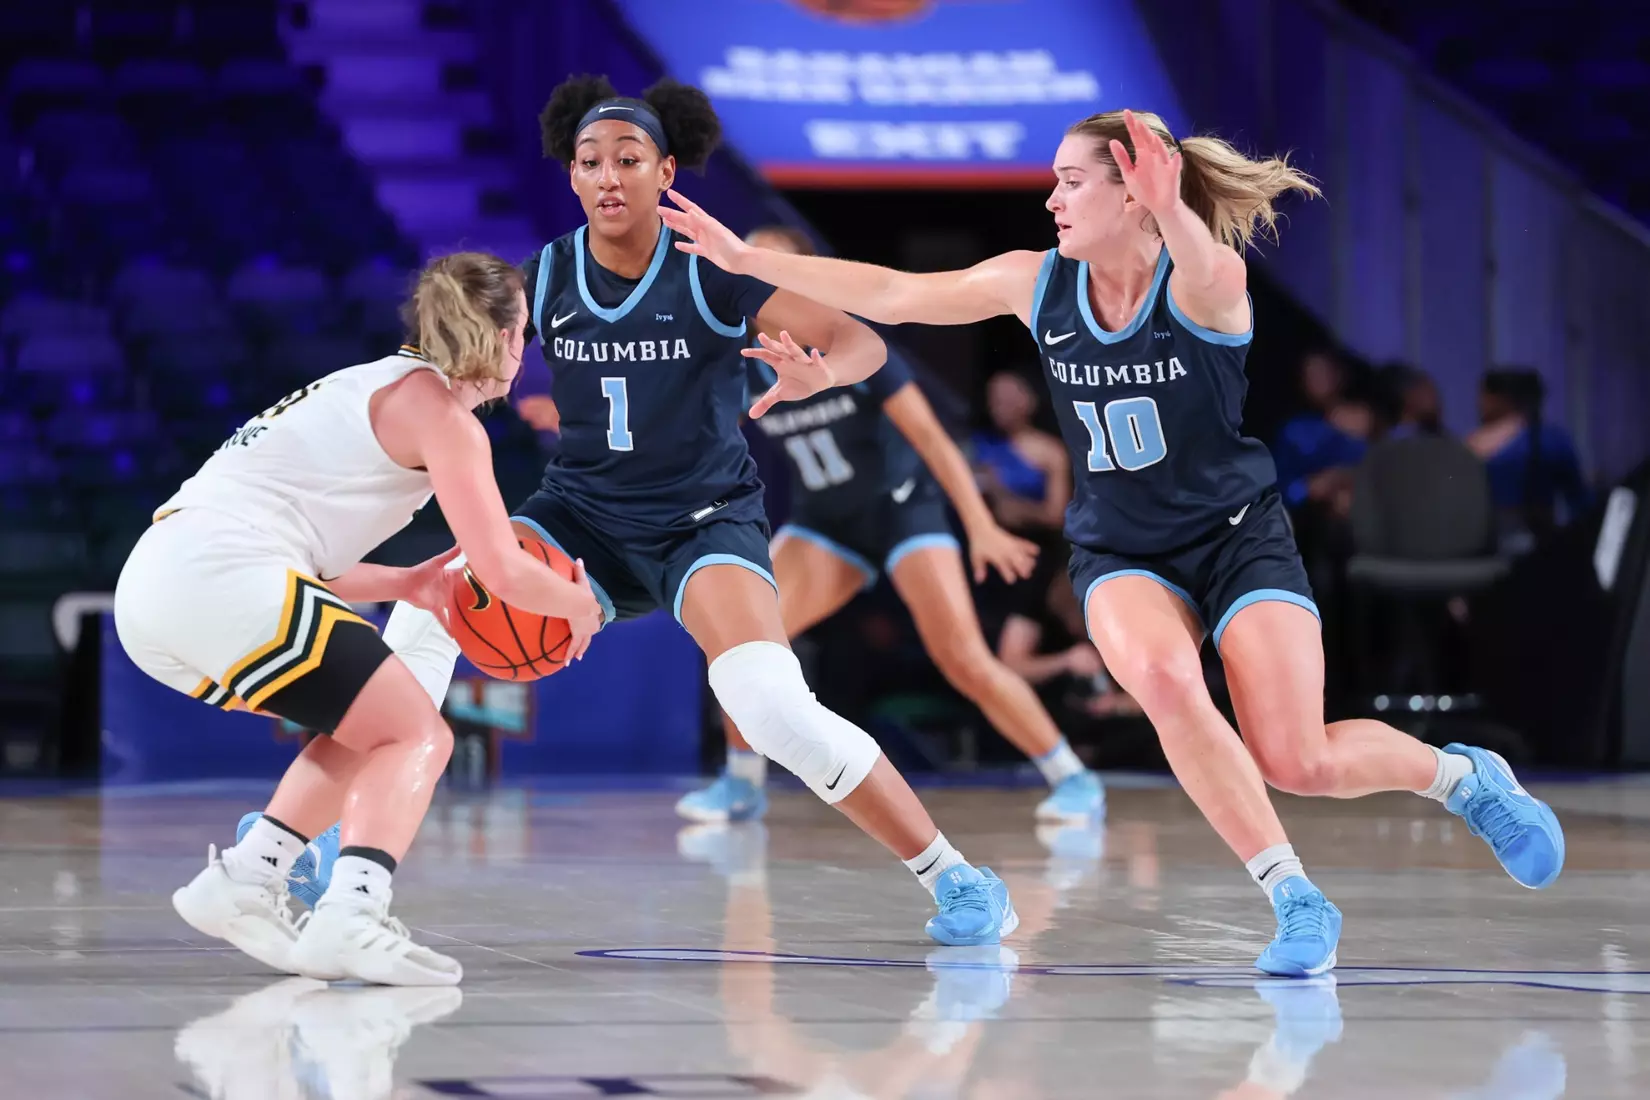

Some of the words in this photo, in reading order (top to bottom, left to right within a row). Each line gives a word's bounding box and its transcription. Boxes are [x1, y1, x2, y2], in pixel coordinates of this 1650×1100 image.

[554, 337, 691, 362] COLUMBIA
[1048, 356, 1187, 386] COLUMBIA
[600, 377, 634, 451] 1
[1072, 396, 1168, 472] 10
[785, 429, 854, 490] 11
